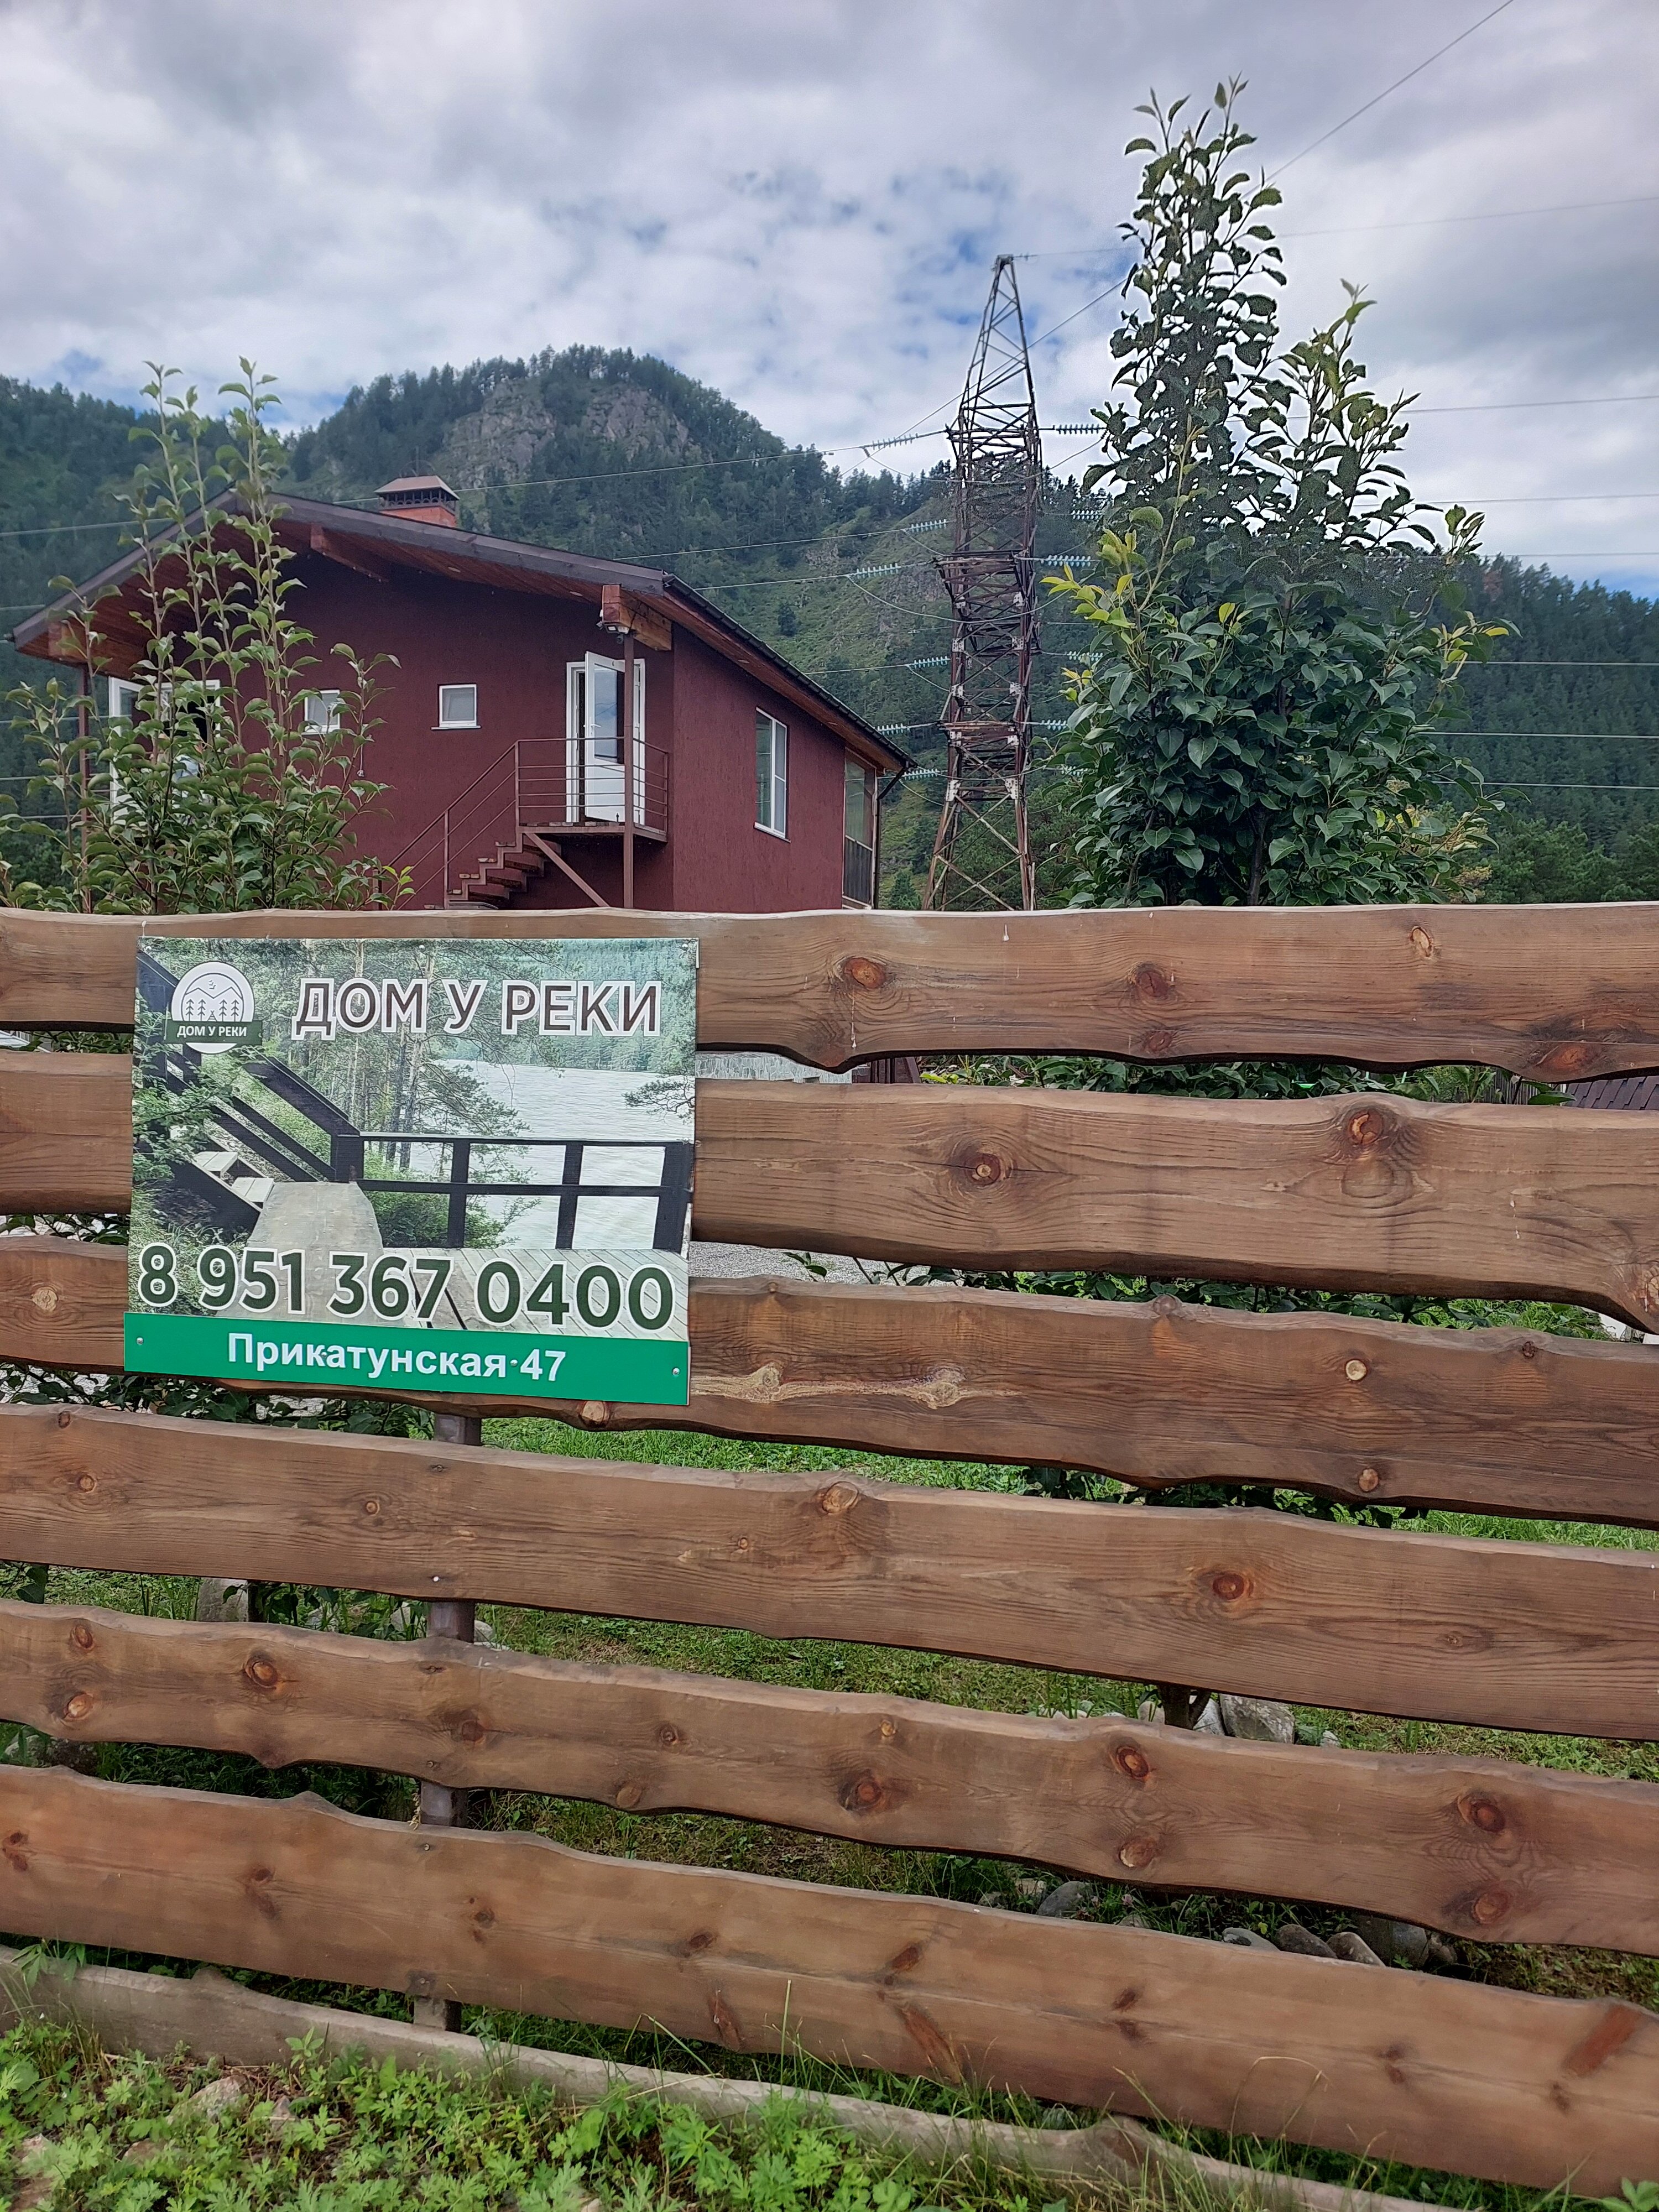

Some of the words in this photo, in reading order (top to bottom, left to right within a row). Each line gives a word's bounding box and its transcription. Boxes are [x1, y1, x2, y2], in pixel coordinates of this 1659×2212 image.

[176, 1025, 206, 1039] ДОМ
[207, 1026, 216, 1036] У
[218, 1026, 247, 1037] РЕКИ
[292, 978, 429, 1040] ДОМ
[443, 979, 488, 1034] У
[501, 979, 662, 1036] РЕКИ
[138, 1242, 178, 1307] 8
[197, 1245, 306, 1314] 951
[326, 1251, 454, 1321] 367
[474, 1258, 676, 1331] 0400
[228, 1332, 506, 1379] Прикатунская
[519, 1349, 567, 1382] 47
